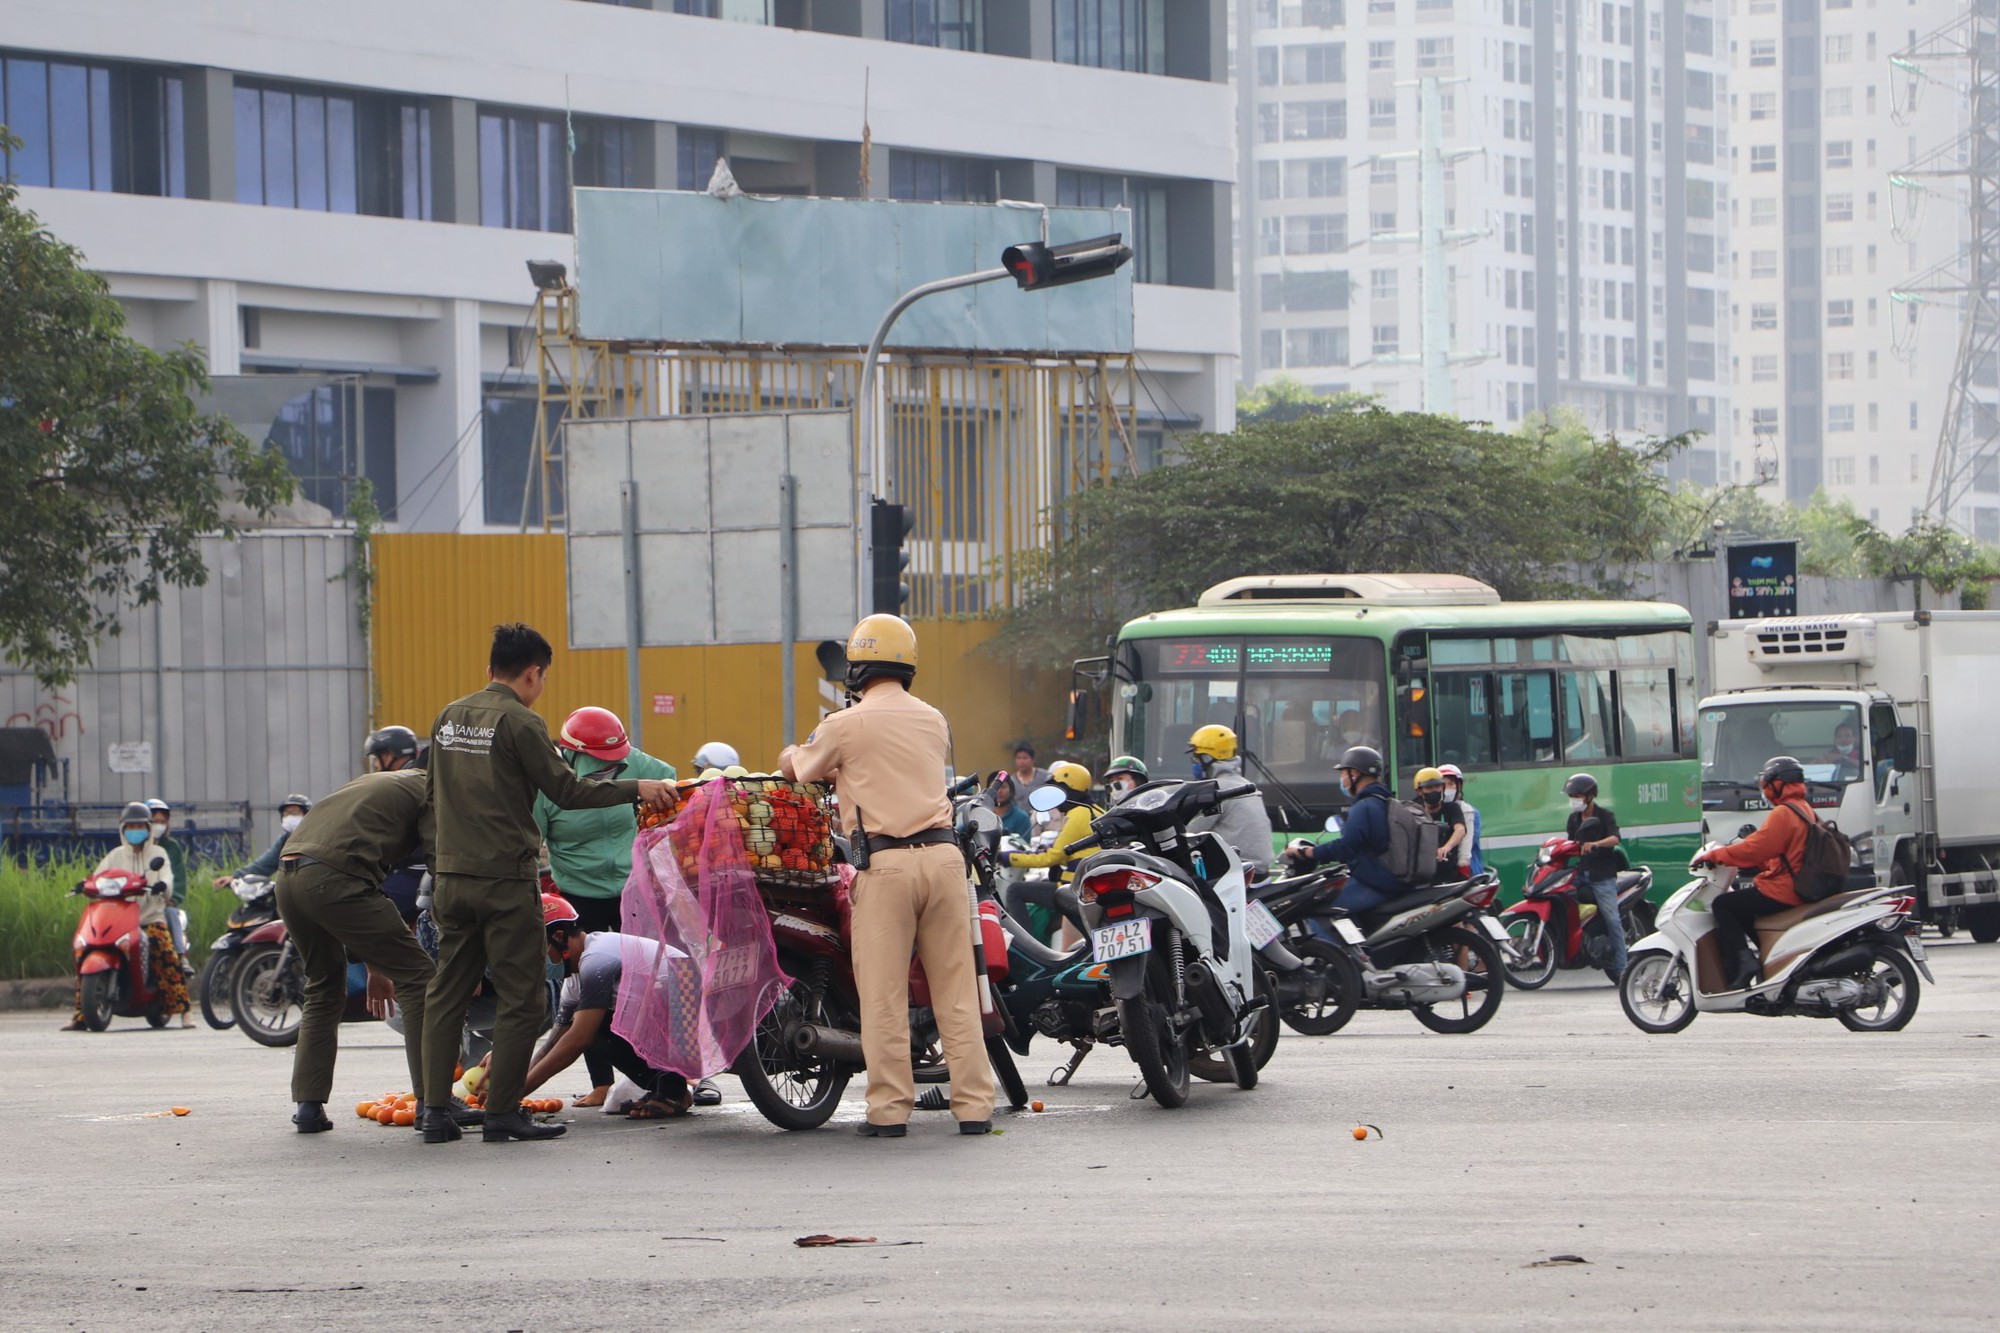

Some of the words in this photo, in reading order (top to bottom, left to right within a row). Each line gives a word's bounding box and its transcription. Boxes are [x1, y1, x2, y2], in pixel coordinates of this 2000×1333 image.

[1764, 625, 1802, 633] THERMAL
[1805, 623, 1839, 631] MASTER
[1744, 799, 1774, 810] ISU
[1098, 936, 1145, 961] 707.51
